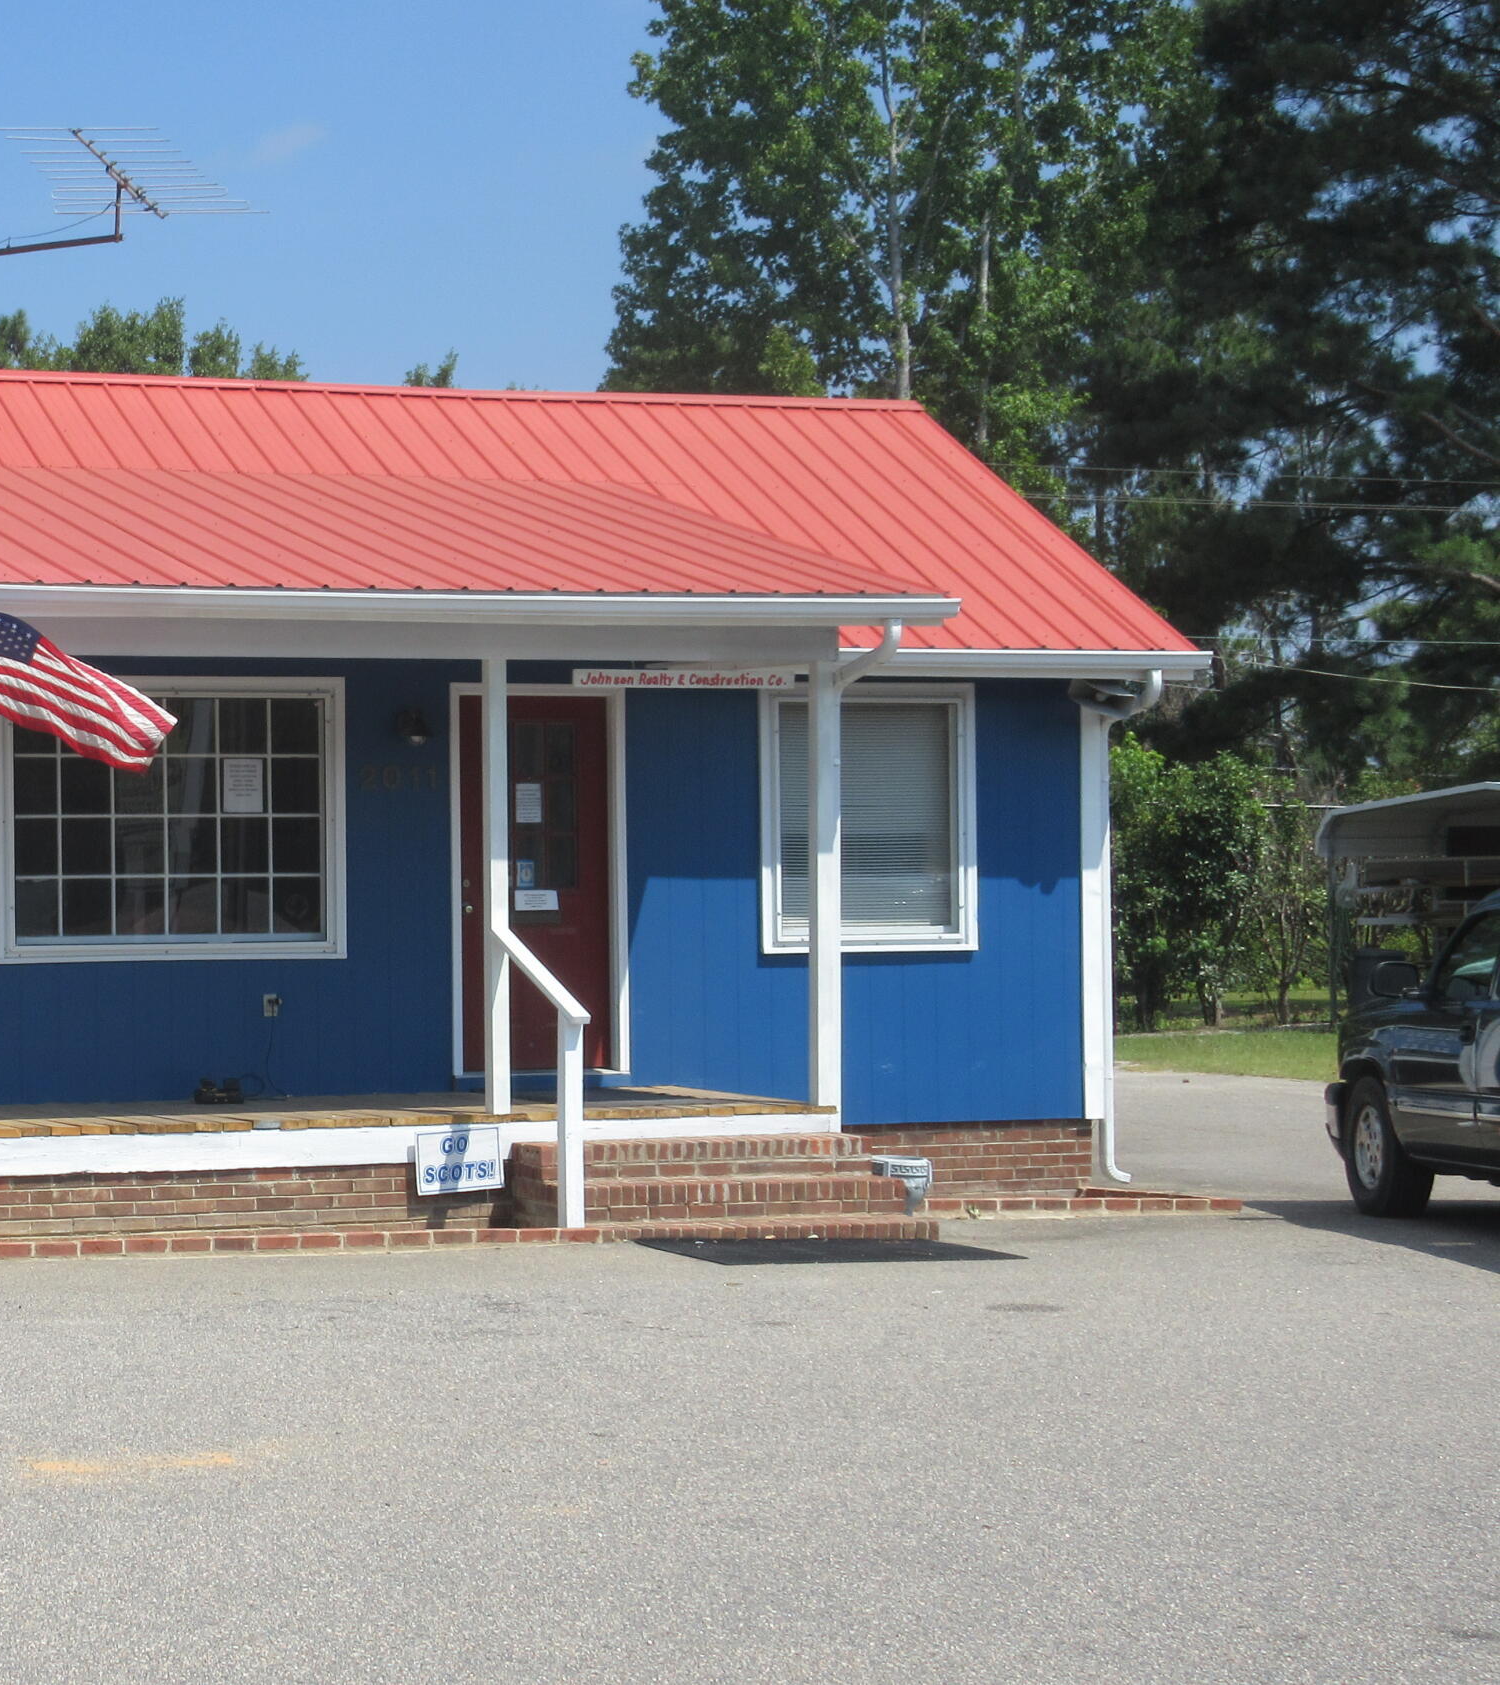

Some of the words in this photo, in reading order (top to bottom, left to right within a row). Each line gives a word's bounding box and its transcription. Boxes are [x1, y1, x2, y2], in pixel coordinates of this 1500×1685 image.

[580, 671, 635, 686] Johnson
[638, 672, 674, 686] Realty
[688, 671, 764, 687] Construction
[768, 673, 788, 687] Co.
[441, 1134, 469, 1155] GO
[424, 1160, 496, 1185] SCOTS!
